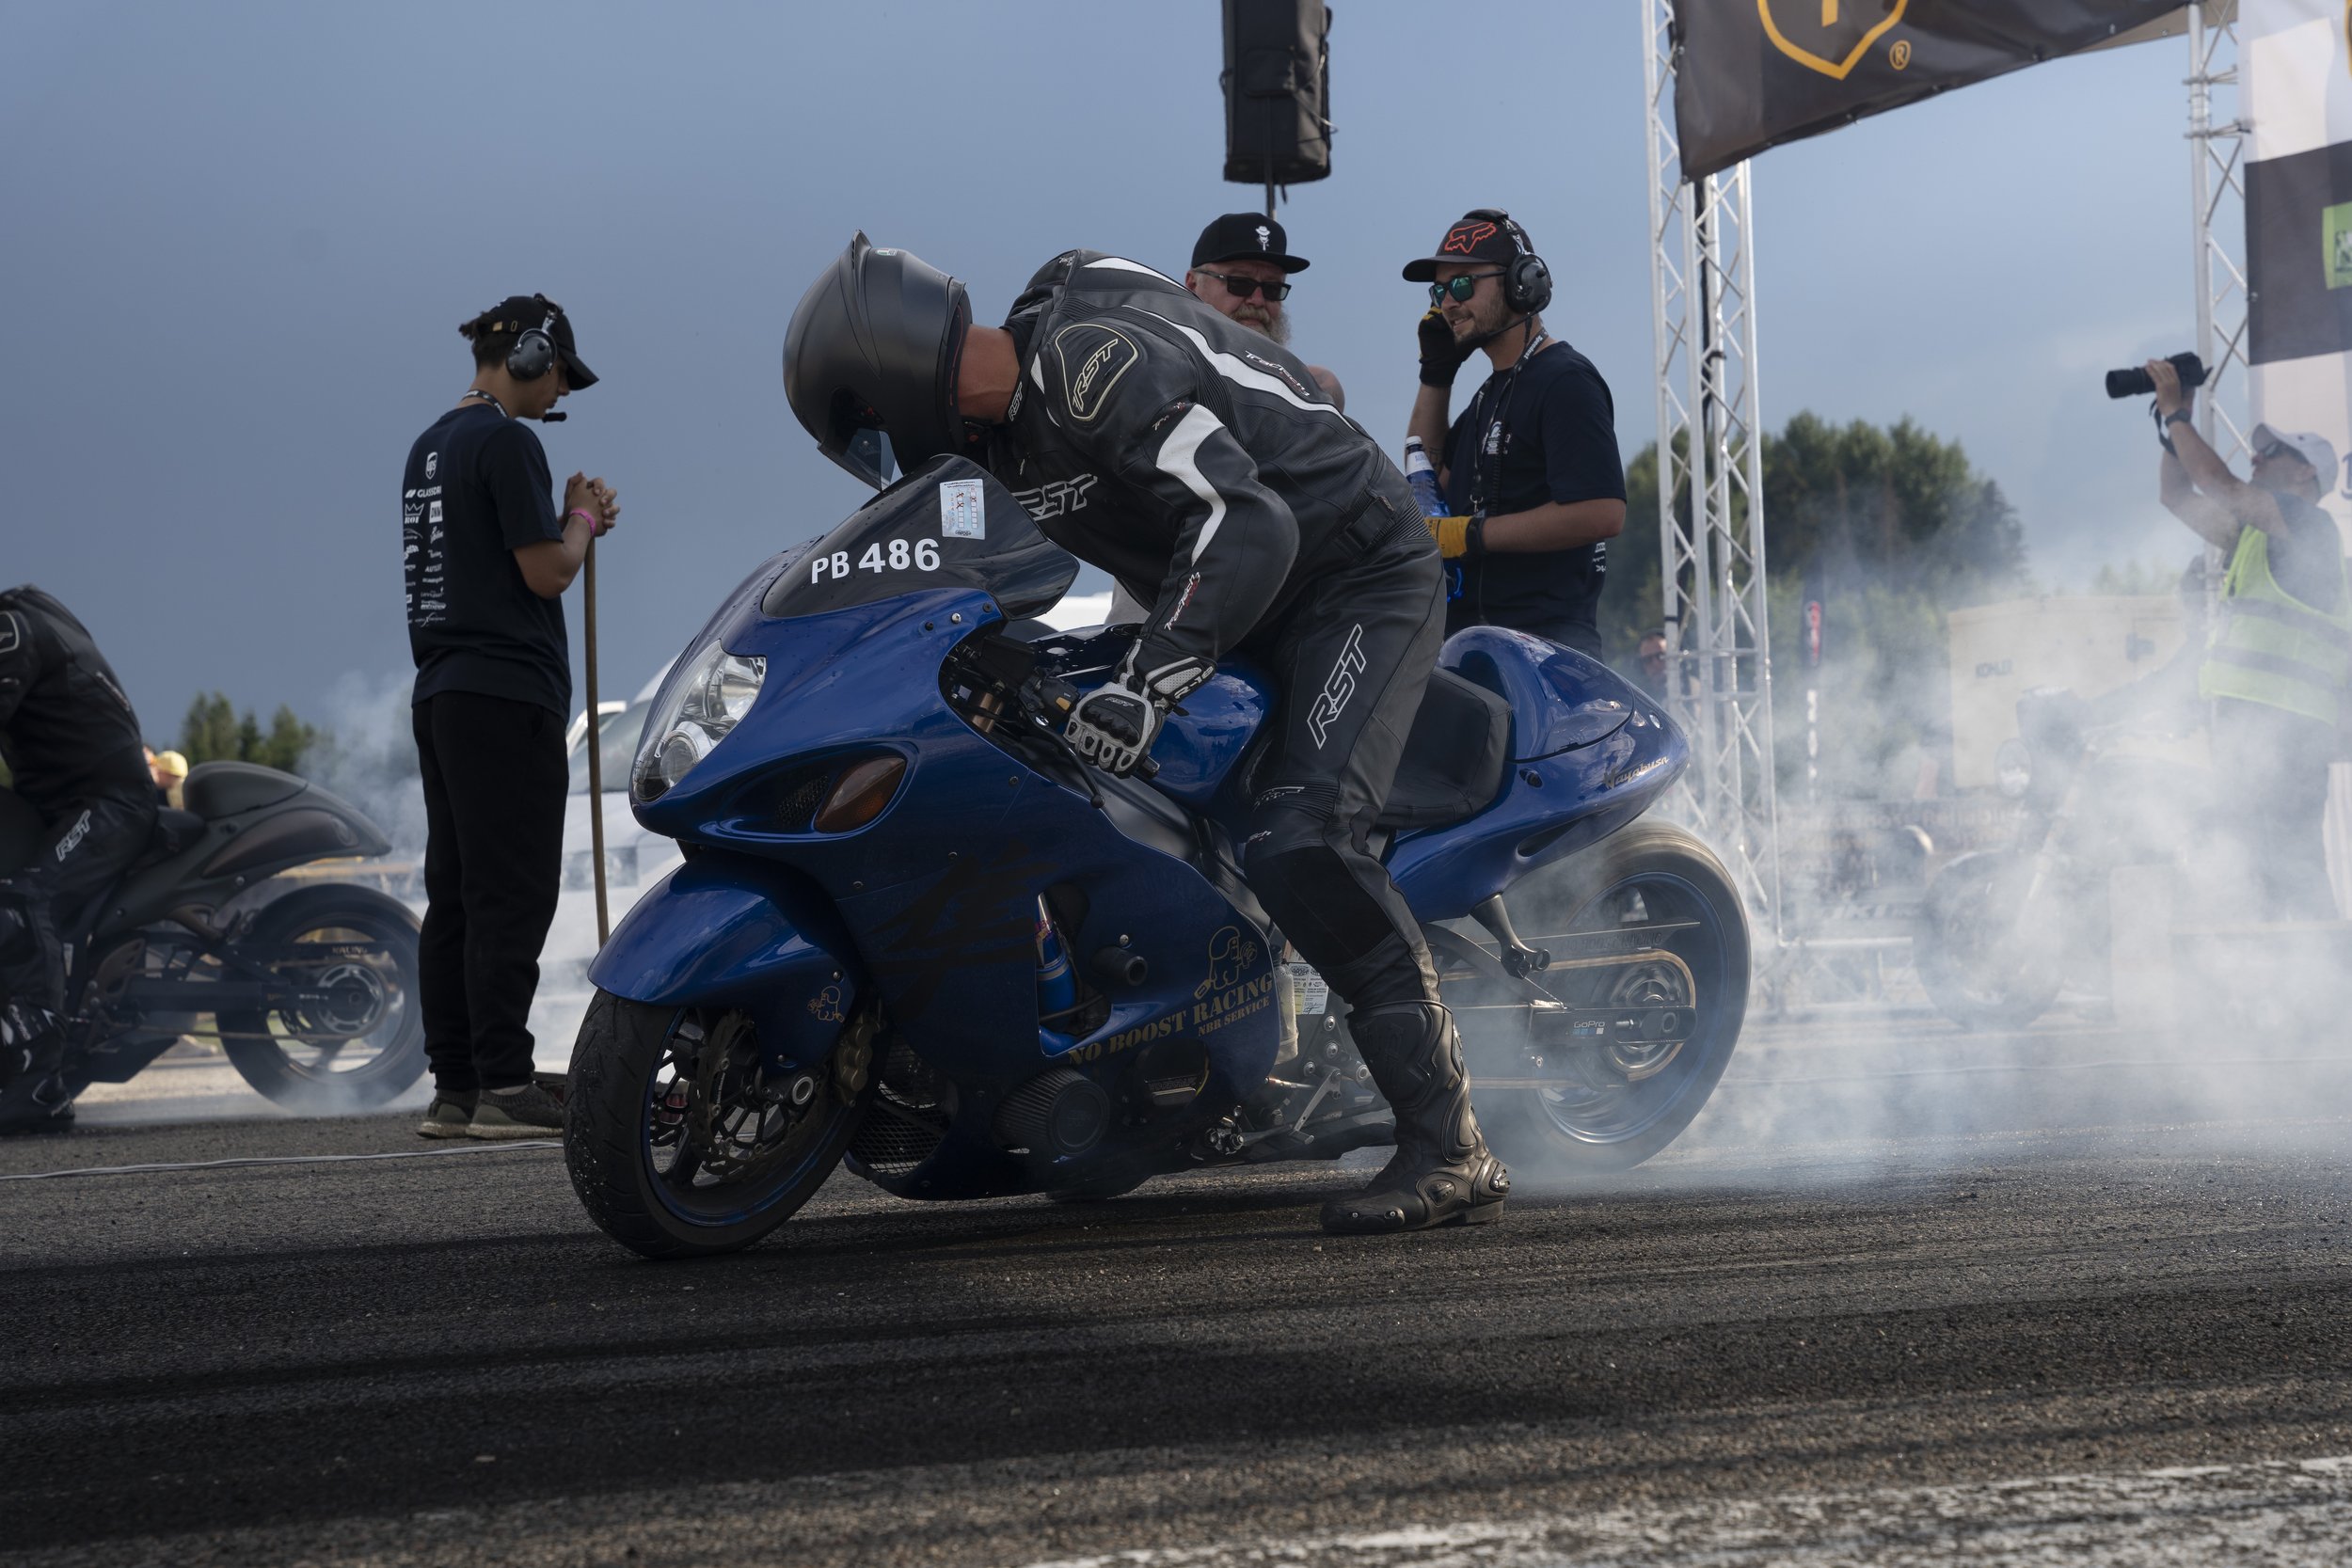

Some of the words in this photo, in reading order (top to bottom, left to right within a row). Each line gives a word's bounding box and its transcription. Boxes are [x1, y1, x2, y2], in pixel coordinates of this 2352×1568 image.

[1073, 338, 1119, 413] RST
[1008, 381, 1024, 421] RST
[1010, 472, 1099, 521] RST
[811, 550, 850, 584] PB
[858, 538, 941, 574] 486
[1307, 623, 1367, 751] RST
[1603, 755, 1670, 790] Hayabusa
[56, 808, 91, 863] RST
[1068, 1042, 1103, 1066] NO
[1108, 1007, 1187, 1055] BOOST
[1193, 972, 1273, 1025] RACING
[1198, 1020, 1222, 1037] NBR
[1224, 994, 1270, 1028] SERVICE
[1573, 1020, 1606, 1029] GoPro
